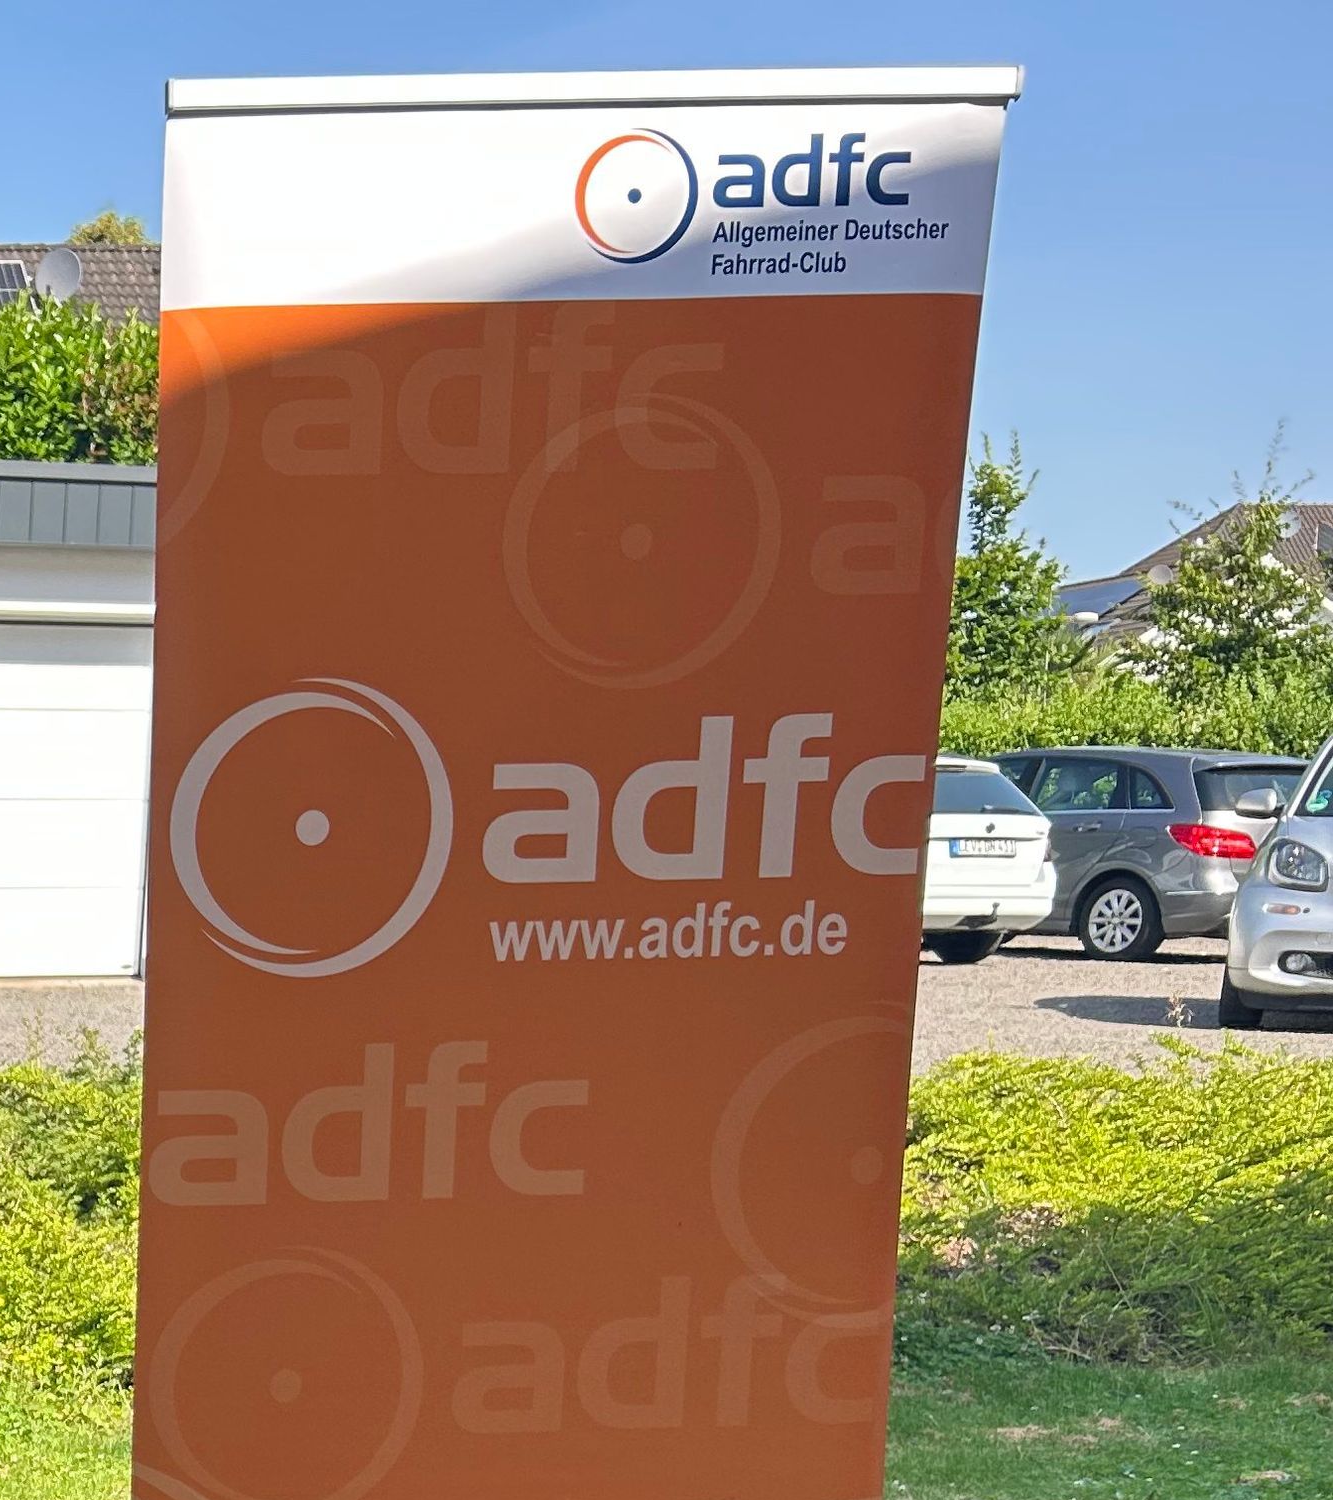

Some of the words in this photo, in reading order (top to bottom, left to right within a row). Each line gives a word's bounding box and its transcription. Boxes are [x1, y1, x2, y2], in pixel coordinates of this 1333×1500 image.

[712, 133, 912, 208] adfc
[711, 250, 847, 276] Fahrrad-Club
[712, 219, 839, 248] Allgemeiner
[844, 217, 949, 241] Deutscher
[481, 712, 927, 884] adfc
[489, 900, 849, 963] www.adfc.de
[147, 1040, 590, 1207] adfc
